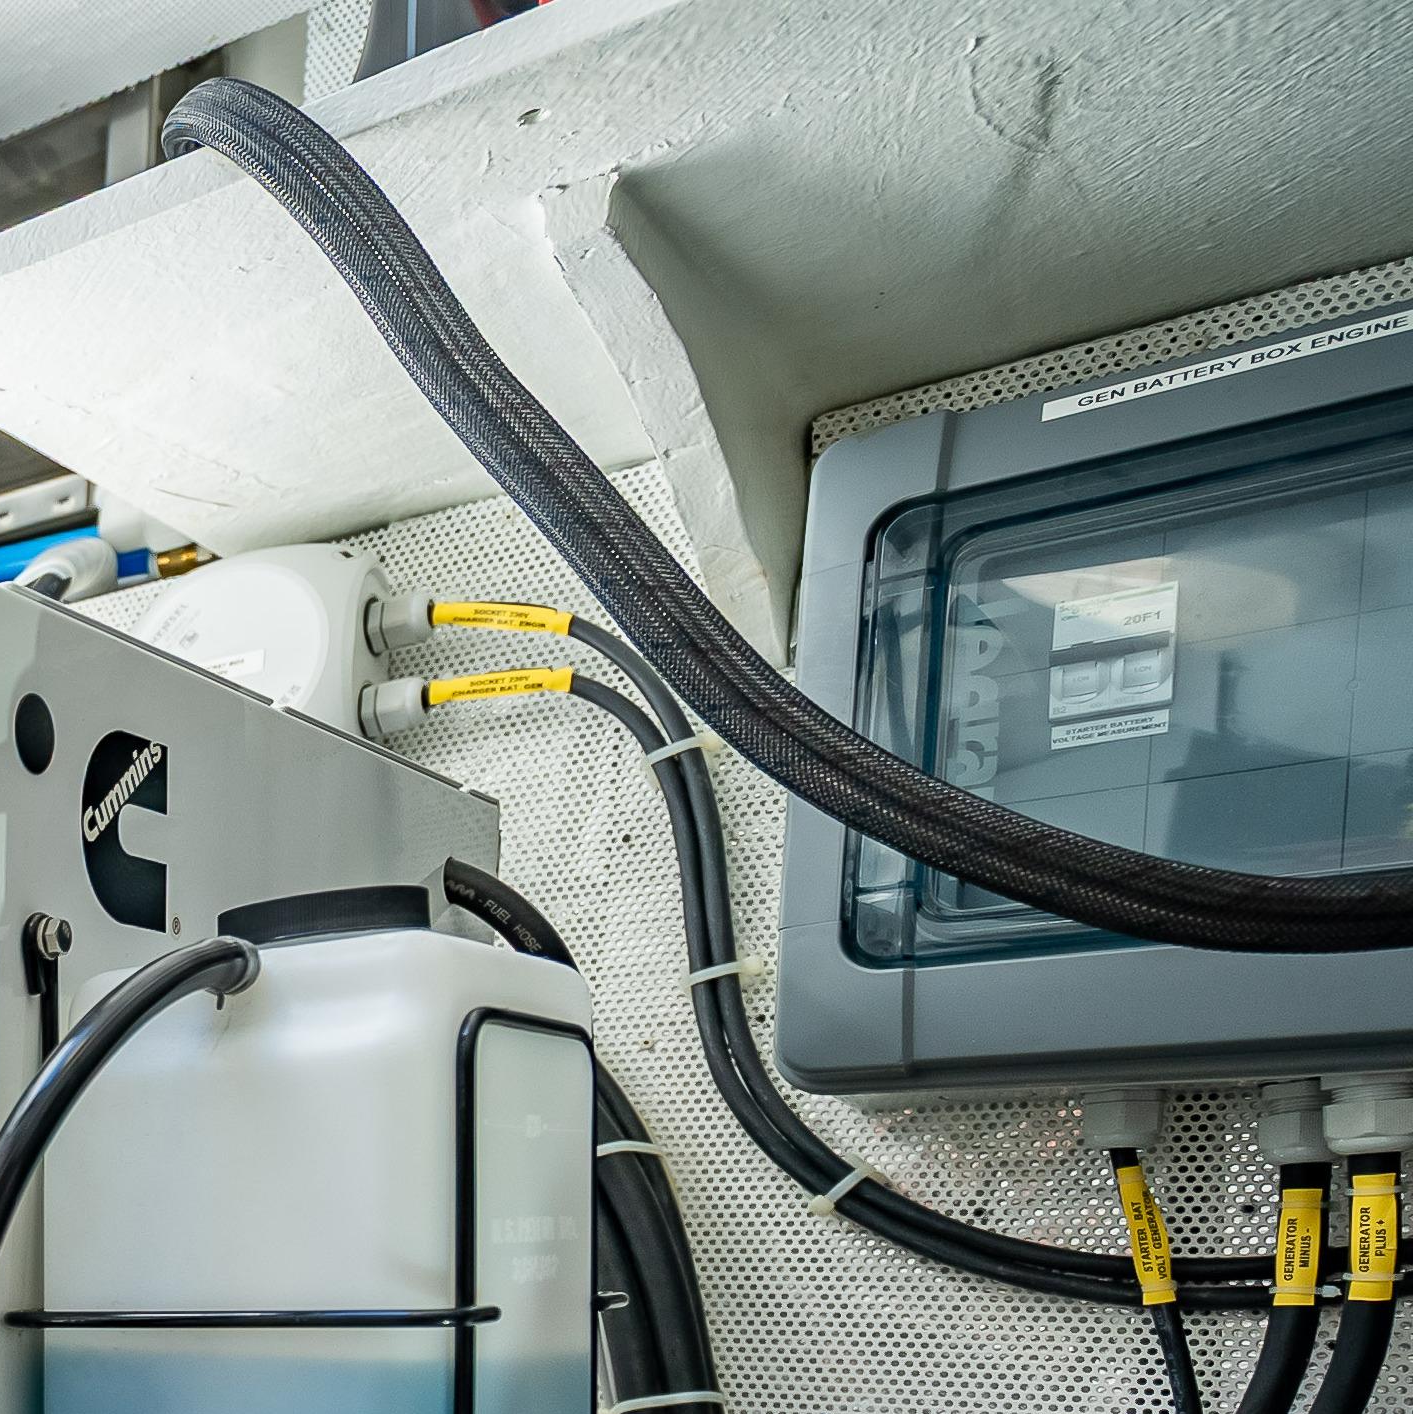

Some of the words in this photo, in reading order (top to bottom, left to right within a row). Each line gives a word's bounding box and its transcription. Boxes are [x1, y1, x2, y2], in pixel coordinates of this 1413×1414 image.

[1077, 387, 1125, 407] GEN
[1133, 358, 1242, 394] BATTERY
[1250, 344, 1303, 365] BOX
[1311, 315, 1409, 350] ENGINE
[453, 616, 494, 624] CHARGER
[1123, 610, 1162, 626] 20F1
[452, 686, 496, 697] CHARGER
[469, 677, 505, 687] SOCKET
[1052, 732, 1095, 745] VOLTAGE
[1097, 721, 1167, 737] MEASUREMENT
[1066, 723, 1107, 736] STARTER
[1110, 716, 1155, 729] BATTERY
[83, 740, 162, 842] Cummins
[483, 899, 512, 925] FUEL
[512, 923, 542, 952] HOSE
[1131, 1201, 1144, 1223] BAT
[1137, 1228, 1154, 1273] STARTER
[1283, 1217, 1299, 1281] GENERATOR
[1299, 1235, 1312, 1268] MINUS
[1359, 1206, 1371, 1273] GENERATOR
[1375, 1229, 1387, 1257] PLUS
[1153, 1255, 1167, 1280] VOLT
